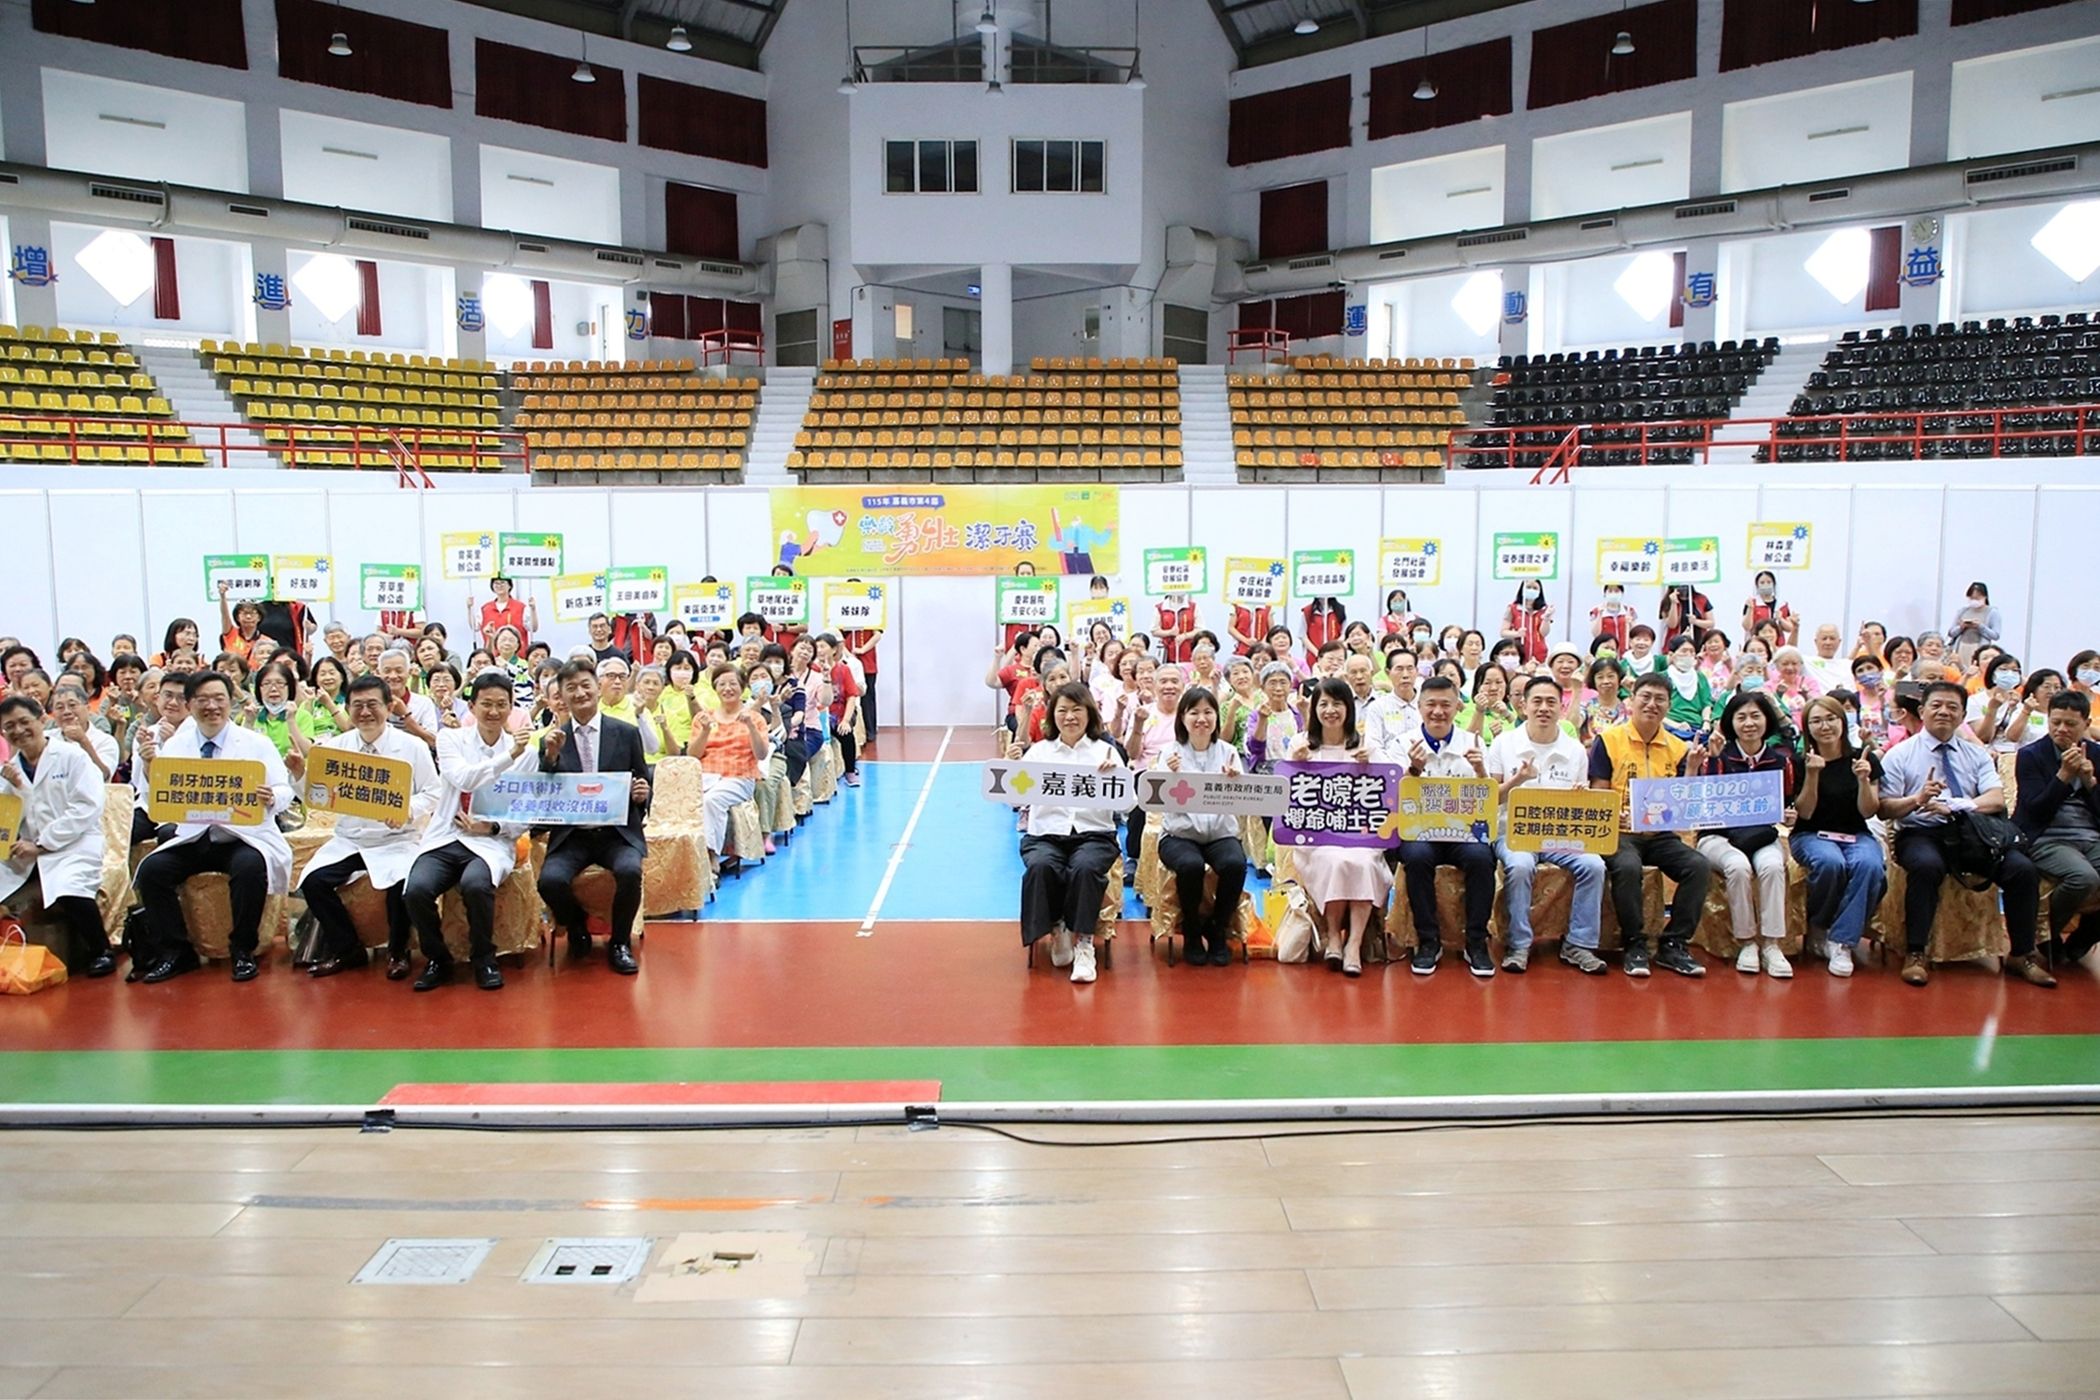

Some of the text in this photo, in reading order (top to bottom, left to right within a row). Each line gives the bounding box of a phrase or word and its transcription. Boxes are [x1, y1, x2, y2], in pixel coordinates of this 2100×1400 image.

[14, 245, 48, 277] 增
[1907, 246, 1939, 278] 益
[257, 273, 285, 302] 進
[1688, 271, 1714, 300] 有
[458, 297, 481, 323] 活
[1504, 291, 1525, 316] 動
[627, 308, 646, 332] 力
[1346, 305, 1366, 330] 運
[867, 497, 890, 506] 115年
[1765, 540, 1793, 550] 林森里
[1393, 557, 1426, 567] 北門社區
[1764, 552, 1791, 562] 辦公處
[1392, 568, 1425, 578] 發展協會
[1610, 561, 1651, 572] 幸福樂齡
[217, 578, 261, 588] 亮刷刷隊
[290, 578, 318, 588] 好友隊
[1162, 574, 1189, 582] 發展協會
[1239, 576, 1273, 586] 中庄社區
[378, 594, 404, 604] 辦公處
[1238, 587, 1271, 598] 發展協會
[565, 595, 602, 608] 新店潔牙
[684, 604, 726, 614] 東區衛生所
[761, 606, 794, 616] 發展協會
[325, 758, 391, 785] 勇壯健康
[169, 773, 243, 789] 刷牙加牙線
[1041, 771, 1126, 799] 嘉義市
[1204, 782, 1283, 795] 嘉義市政府衛生局
[156, 790, 258, 807] 口腔健康看得見
[338, 782, 404, 809] 從齒開始
[1514, 806, 1613, 822] 口腔保健要做好
[1513, 822, 1612, 838] 定期檢查不可少
